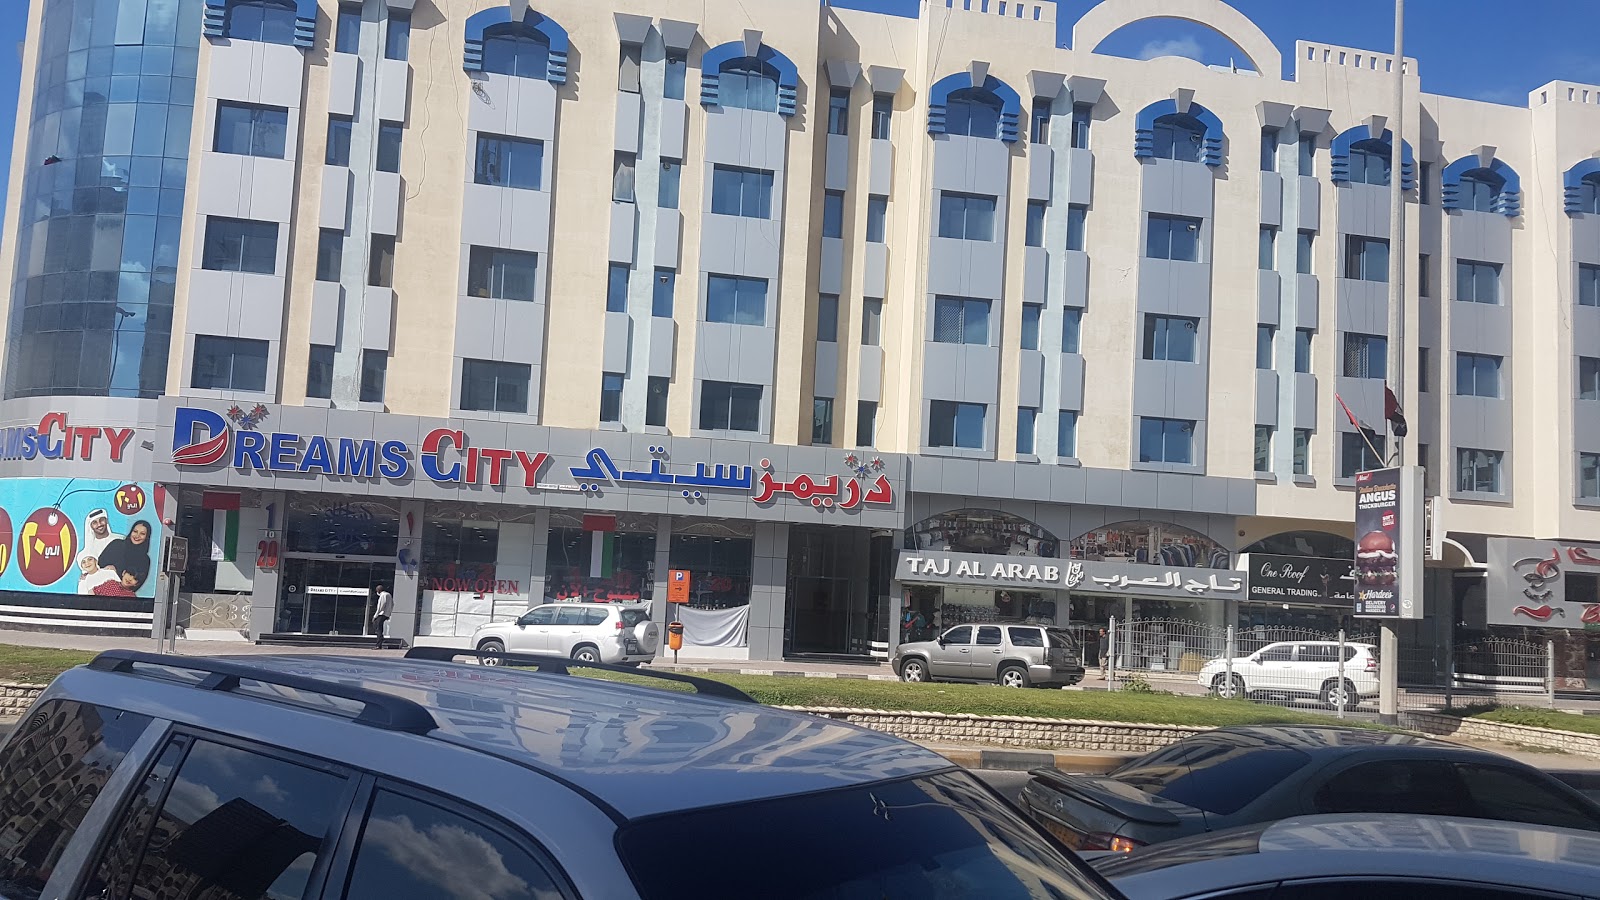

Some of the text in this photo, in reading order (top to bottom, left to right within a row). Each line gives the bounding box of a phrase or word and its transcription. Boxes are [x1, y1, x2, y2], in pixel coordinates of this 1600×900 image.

[37, 411, 134, 461] CITY
[171, 406, 549, 488] DREAMS CITY
[569, 446, 892, 508] دريمز سيتي
[1359, 490, 1396, 504] ANGUS
[256, 540, 278, 567] 20
[676, 572, 683, 580] P
[906, 557, 950, 575] TAJ
[955, 560, 986, 577] AL
[990, 562, 1059, 581] ARAB
[1261, 562, 1310, 583] One Roof
[432, 578, 520, 596] NOW OPEN
[1092, 571, 1182, 588] العرب
[1184, 574, 1242, 593] تاج
[1251, 586, 1318, 597] GENERAL TRADING
[1362, 589, 1394, 600] Hardee's
